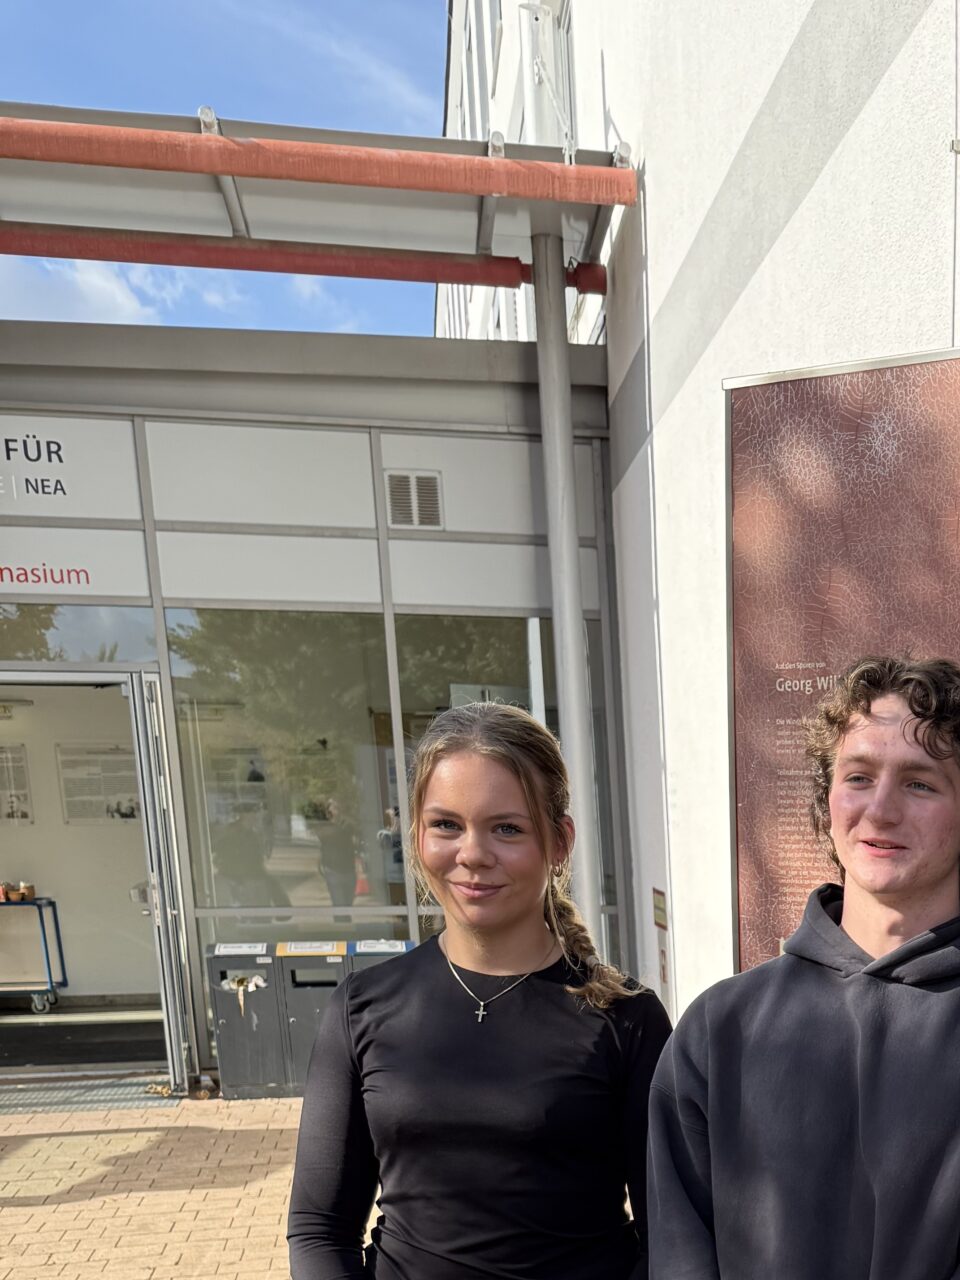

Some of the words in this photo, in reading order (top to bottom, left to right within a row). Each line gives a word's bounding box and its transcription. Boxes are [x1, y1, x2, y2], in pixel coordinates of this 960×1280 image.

[4, 434, 64, 463] FÜR
[24, 477, 67, 496] NEA
[776, 678, 813, 694] Georg
[816, 675, 838, 690] Wil
